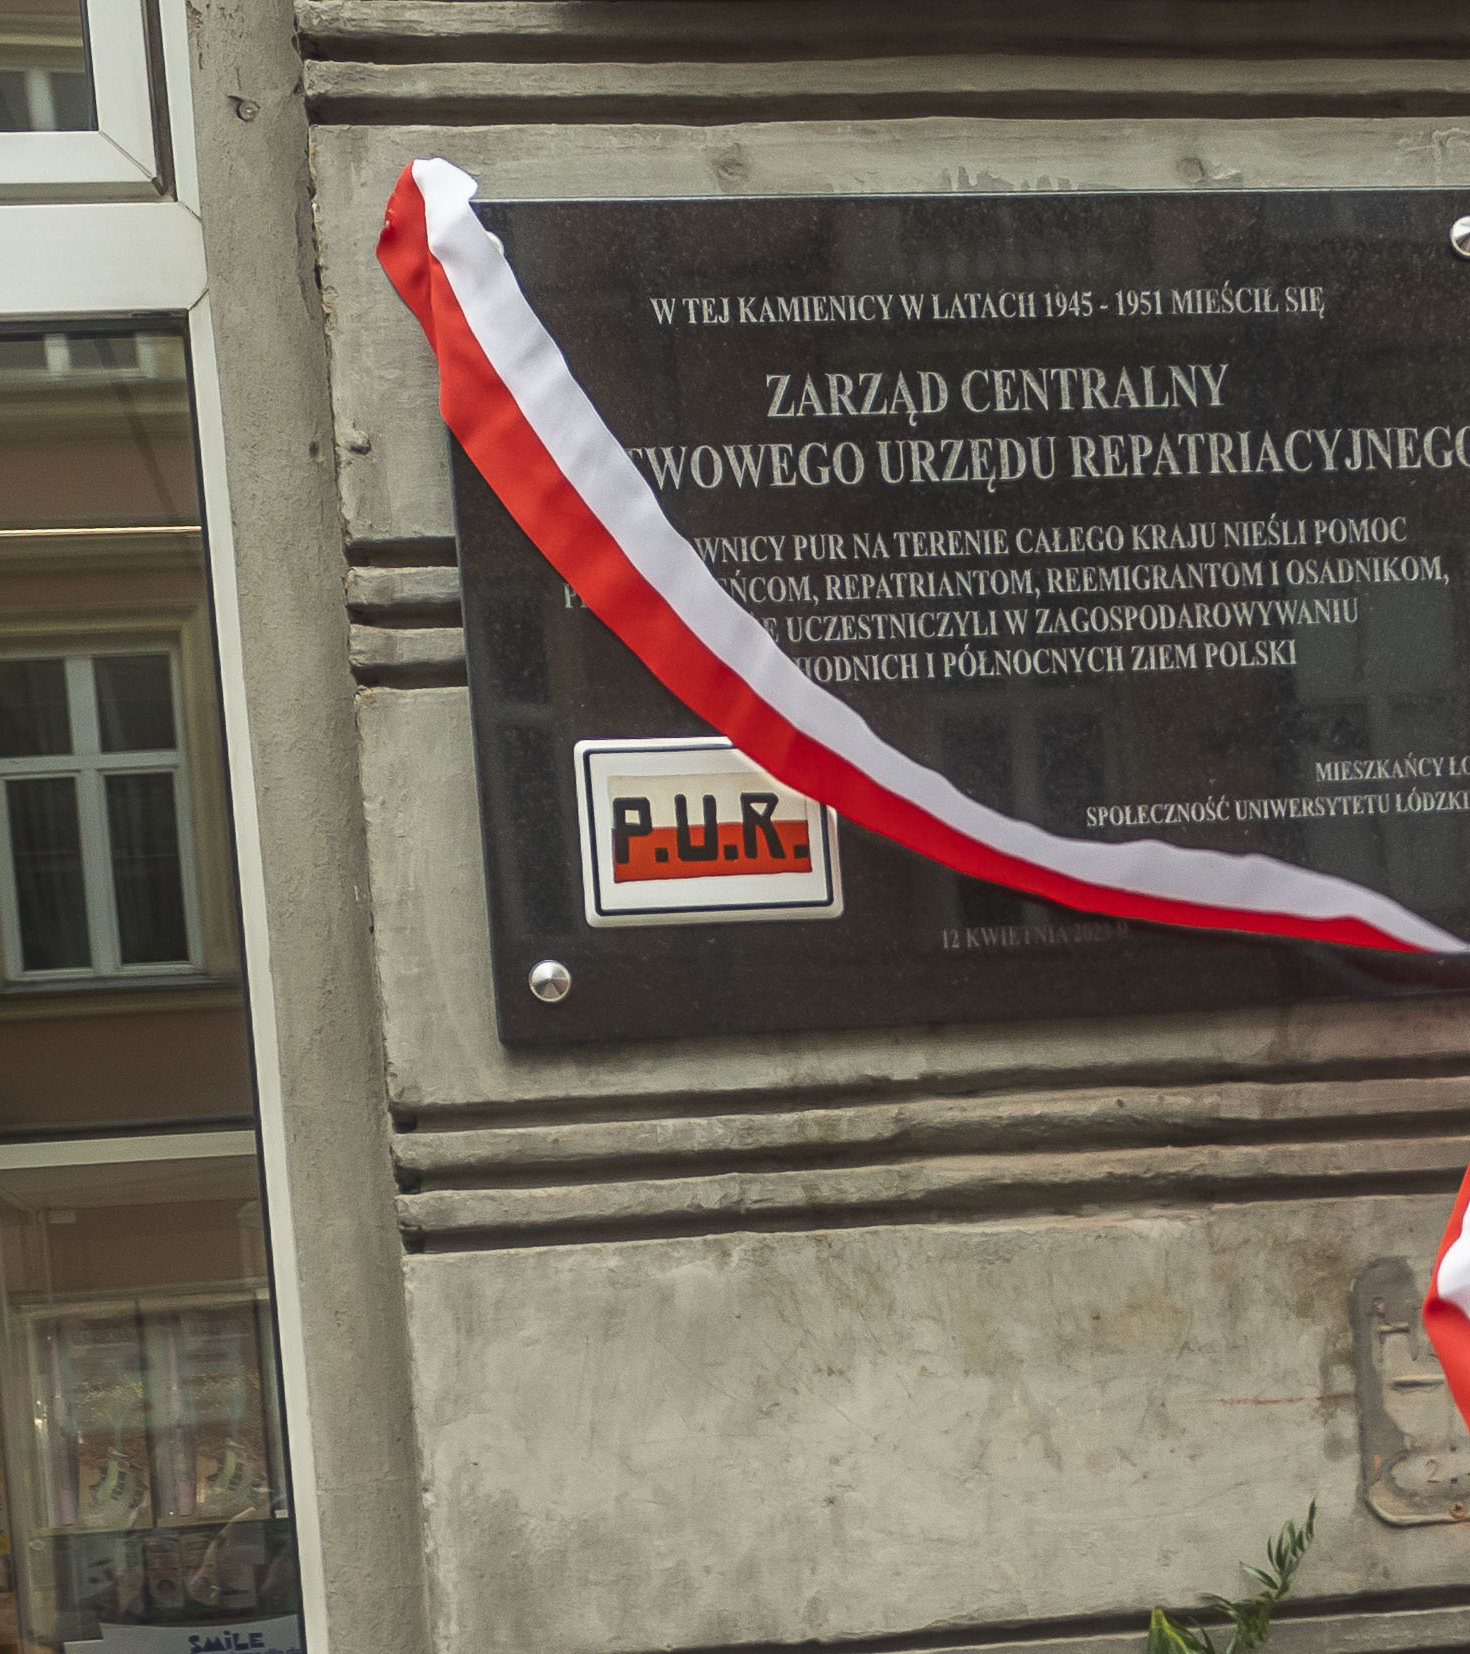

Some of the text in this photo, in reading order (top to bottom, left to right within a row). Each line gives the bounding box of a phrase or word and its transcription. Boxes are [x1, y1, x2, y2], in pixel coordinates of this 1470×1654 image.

[650, 297, 676, 325] W
[682, 296, 730, 325] TEJ
[737, 294, 894, 323] KAMIENICY
[899, 293, 924, 321] W
[931, 291, 1036, 320] LATACH
[1044, 290, 1093, 318] 1945
[1115, 288, 1163, 316] 1951
[1169, 280, 1279, 315] MIEŚCIŁ
[1285, 286, 1325, 320] SIĘ
[766, 363, 1228, 426] ZARZĄD CENTRALNY
[876, 433, 1055, 492] URZĘDU
[794, 532, 846, 562] PUR
[853, 531, 891, 559] NA
[893, 528, 1009, 557] TERENIE
[1015, 523, 1125, 555] CAŁEGO
[1131, 520, 1217, 551] KRAJU
[1223, 512, 1307, 548] NIEŚLI
[1314, 515, 1408, 546] POMOC
[826, 568, 1042, 606] REPATRIANTOM,
[1047, 561, 1262, 595] REEMIGRANTOM
[1271, 559, 1280, 586] I
[1286, 555, 1451, 588] OSADNIKOM,
[786, 608, 1000, 645] UCZESTNICZYLI
[1005, 607, 1030, 636] W
[1036, 597, 1360, 636] ZAGOSPODAROWYWANIU
[927, 651, 938, 676] I
[943, 642, 1124, 678] PÓŁNOCNYCH
[1130, 642, 1197, 671] ZIEM
[1203, 639, 1298, 669] POLSKI
[1315, 751, 1444, 783] MIESZKAŃCY
[613, 792, 810, 863] P.U.R.
[1086, 793, 1230, 828] SPOŁECZNOŚĆ
[1233, 792, 1390, 821] UNIWERSYTETU
[941, 926, 960, 949] 12
[965, 923, 1068, 948] KWIETNIA
